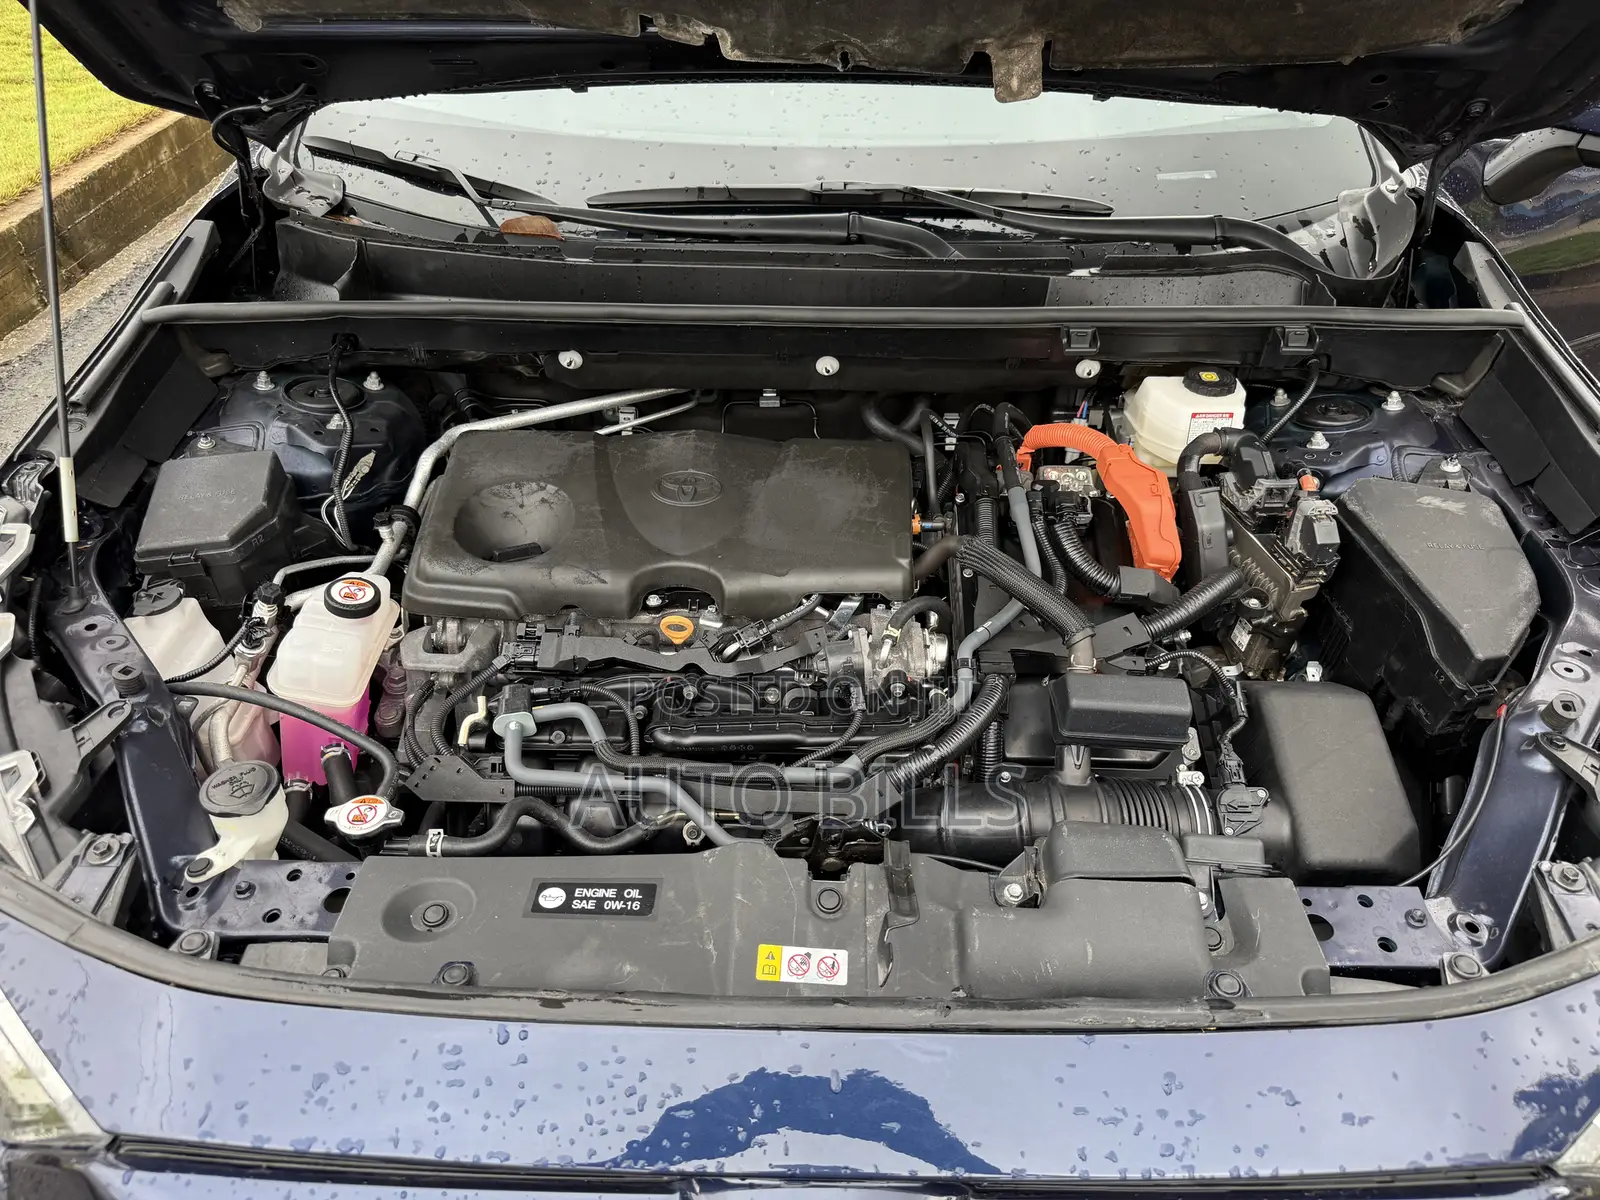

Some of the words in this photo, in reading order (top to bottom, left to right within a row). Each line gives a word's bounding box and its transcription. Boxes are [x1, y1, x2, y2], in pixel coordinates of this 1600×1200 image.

[1425, 541, 1453, 550] RELAY
[1462, 543, 1485, 551] FUSE
[574, 887, 618, 898] ENGINE
[623, 888, 643, 899] OIL
[571, 899, 597, 910] SAE
[603, 900, 641, 911] 0W-16
